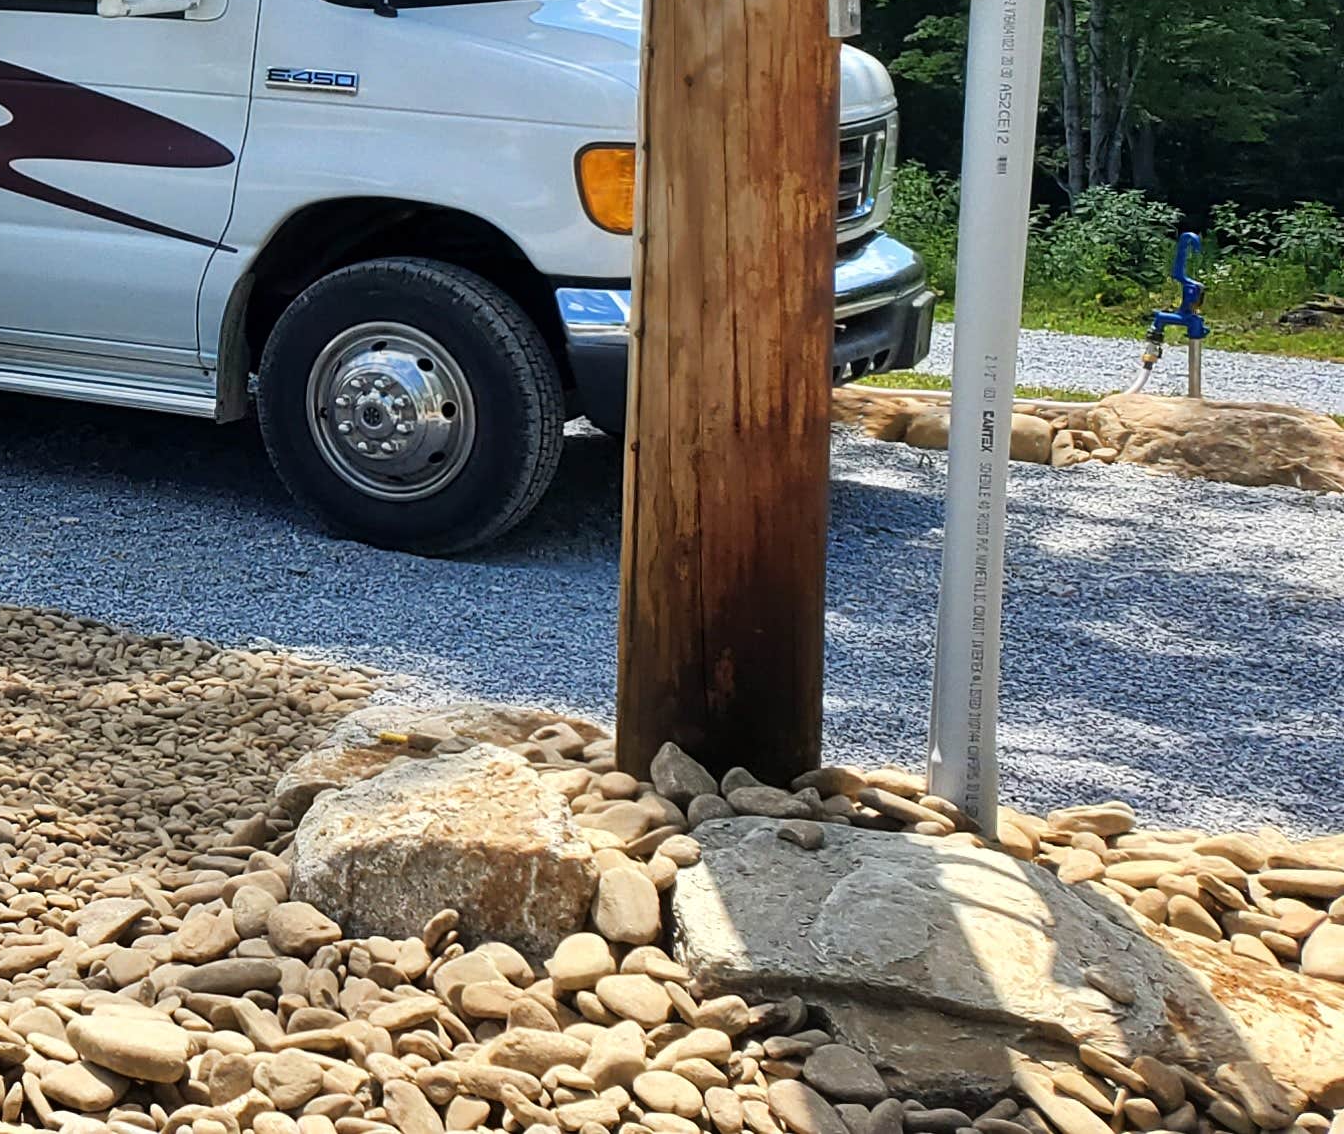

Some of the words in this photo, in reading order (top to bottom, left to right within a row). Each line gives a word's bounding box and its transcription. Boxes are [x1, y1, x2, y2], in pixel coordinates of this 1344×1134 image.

[997, 84, 1012, 144] A52CE12
[981, 411, 994, 453] CANTEX
[979, 463, 992, 497] SCHEDULE
[978, 501, 990, 509] 40
[976, 538, 989, 551] PVC
